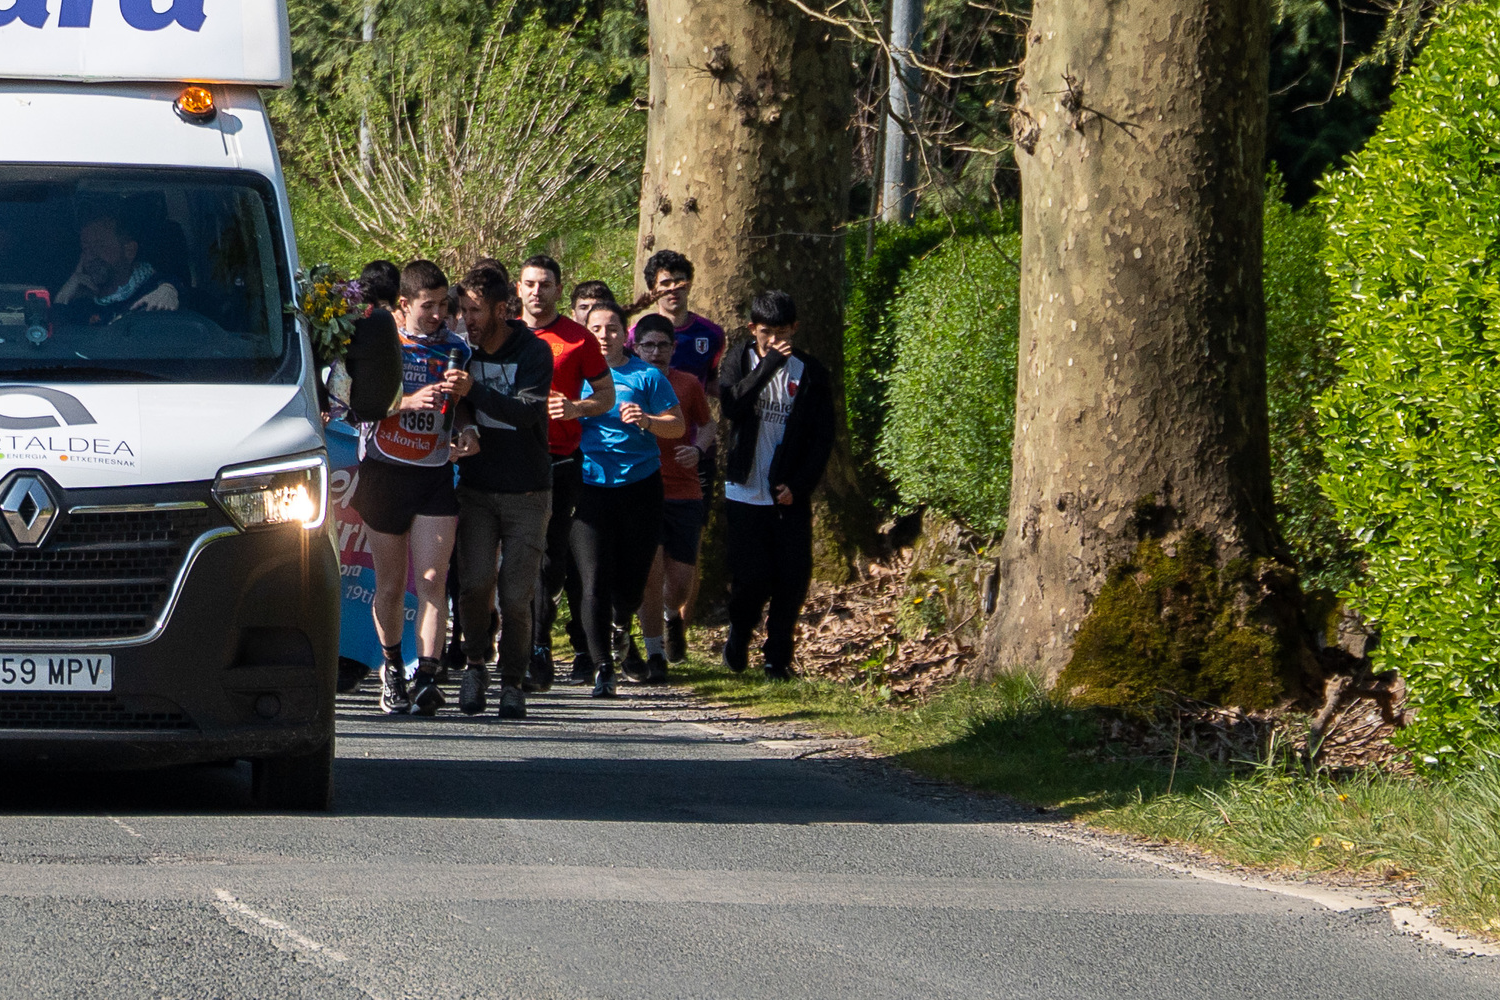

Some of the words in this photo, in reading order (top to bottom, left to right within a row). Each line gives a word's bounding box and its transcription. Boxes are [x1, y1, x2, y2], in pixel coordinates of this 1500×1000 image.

[402, 371, 427, 383] ara
[402, 411, 435, 431] 1369
[380, 430, 431, 451] 24.korrika
[69, 455, 136, 468] ETXETRESNAK
[49, 658, 103, 685] MPV
